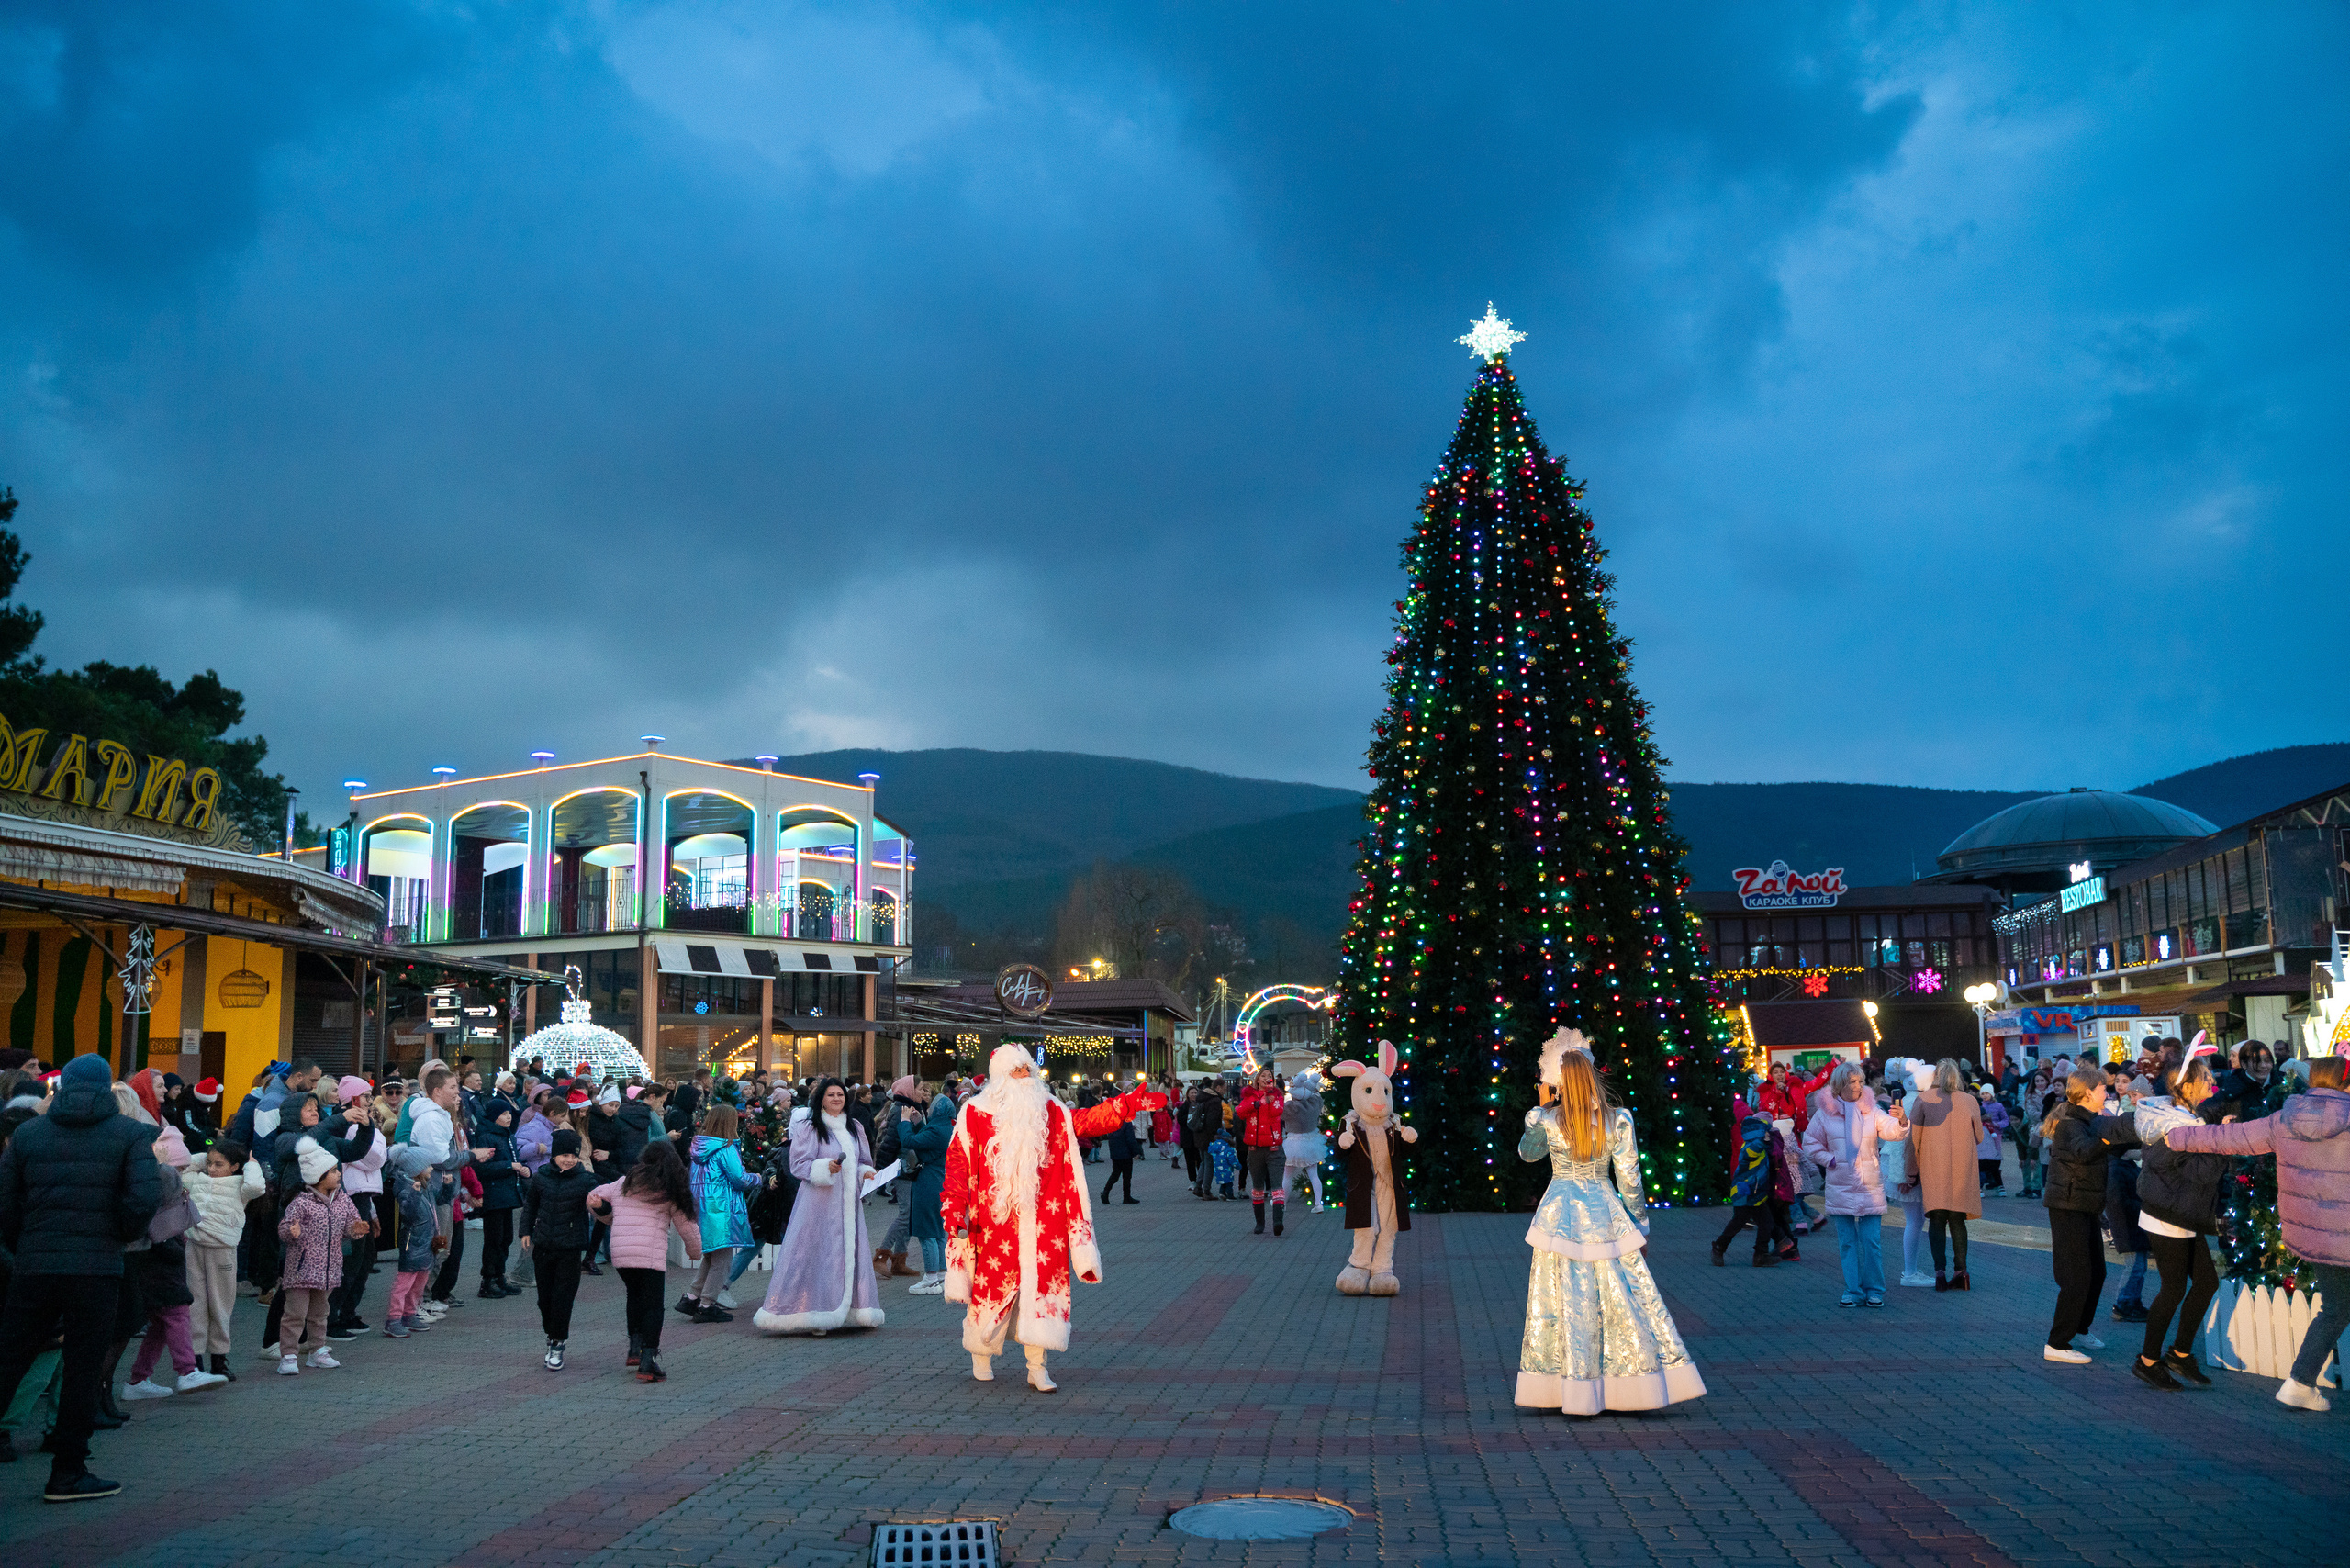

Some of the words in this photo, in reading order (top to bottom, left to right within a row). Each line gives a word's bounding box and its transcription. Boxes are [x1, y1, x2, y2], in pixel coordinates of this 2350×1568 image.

[334, 831, 342, 877] БАЛКО
[1749, 897, 1798, 907] КАРАОКЕ
[1802, 896, 1830, 905] КЛУБ
[2060, 877, 2103, 913] RESTOBAR
[2031, 1011, 2078, 1031] VR
